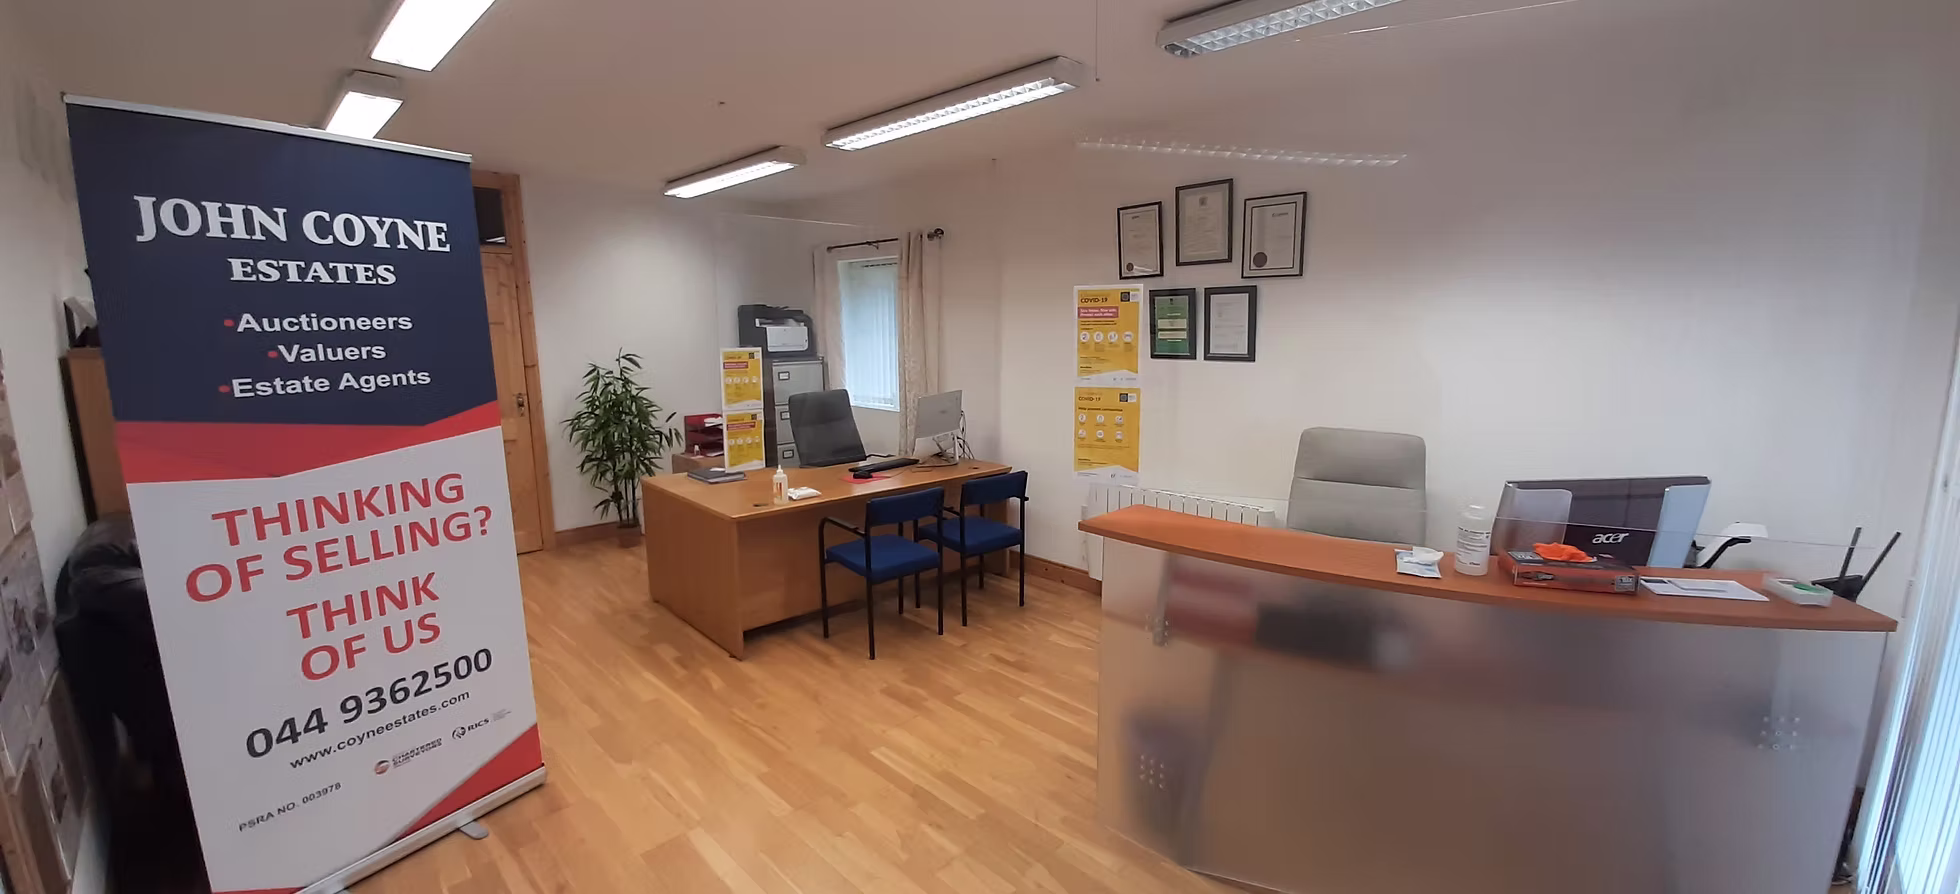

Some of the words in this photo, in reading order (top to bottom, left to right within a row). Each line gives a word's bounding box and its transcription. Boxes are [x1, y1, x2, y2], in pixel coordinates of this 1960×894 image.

[133, 195, 288, 243] JOHN
[302, 210, 451, 252] COYNE
[227, 258, 397, 286] ESTATES
[237, 312, 413, 333] Auctioneers
[278, 343, 387, 364] Valuers
[231, 373, 331, 398] Estate
[338, 368, 432, 392] Agents
[211, 473, 466, 547] THINKING
[185, 554, 266, 603] OF
[282, 505, 493, 582] SELLING?
[1592, 532, 1630, 544] acer
[286, 571, 440, 640] THINK
[300, 634, 367, 682] OF
[382, 612, 442, 655] US
[245, 706, 329, 760] 044
[340, 647, 493, 725] 9362500
[289, 688, 471, 770] www.coyneestates.com
[467, 717, 490, 732] RICS
[391, 737, 442, 763] CHARTERED
[393, 741, 443, 767] SURVEYORS
[238, 811, 275, 832] PSRA
[277, 801, 300, 815] NO.
[302, 782, 342, 804] 003978
